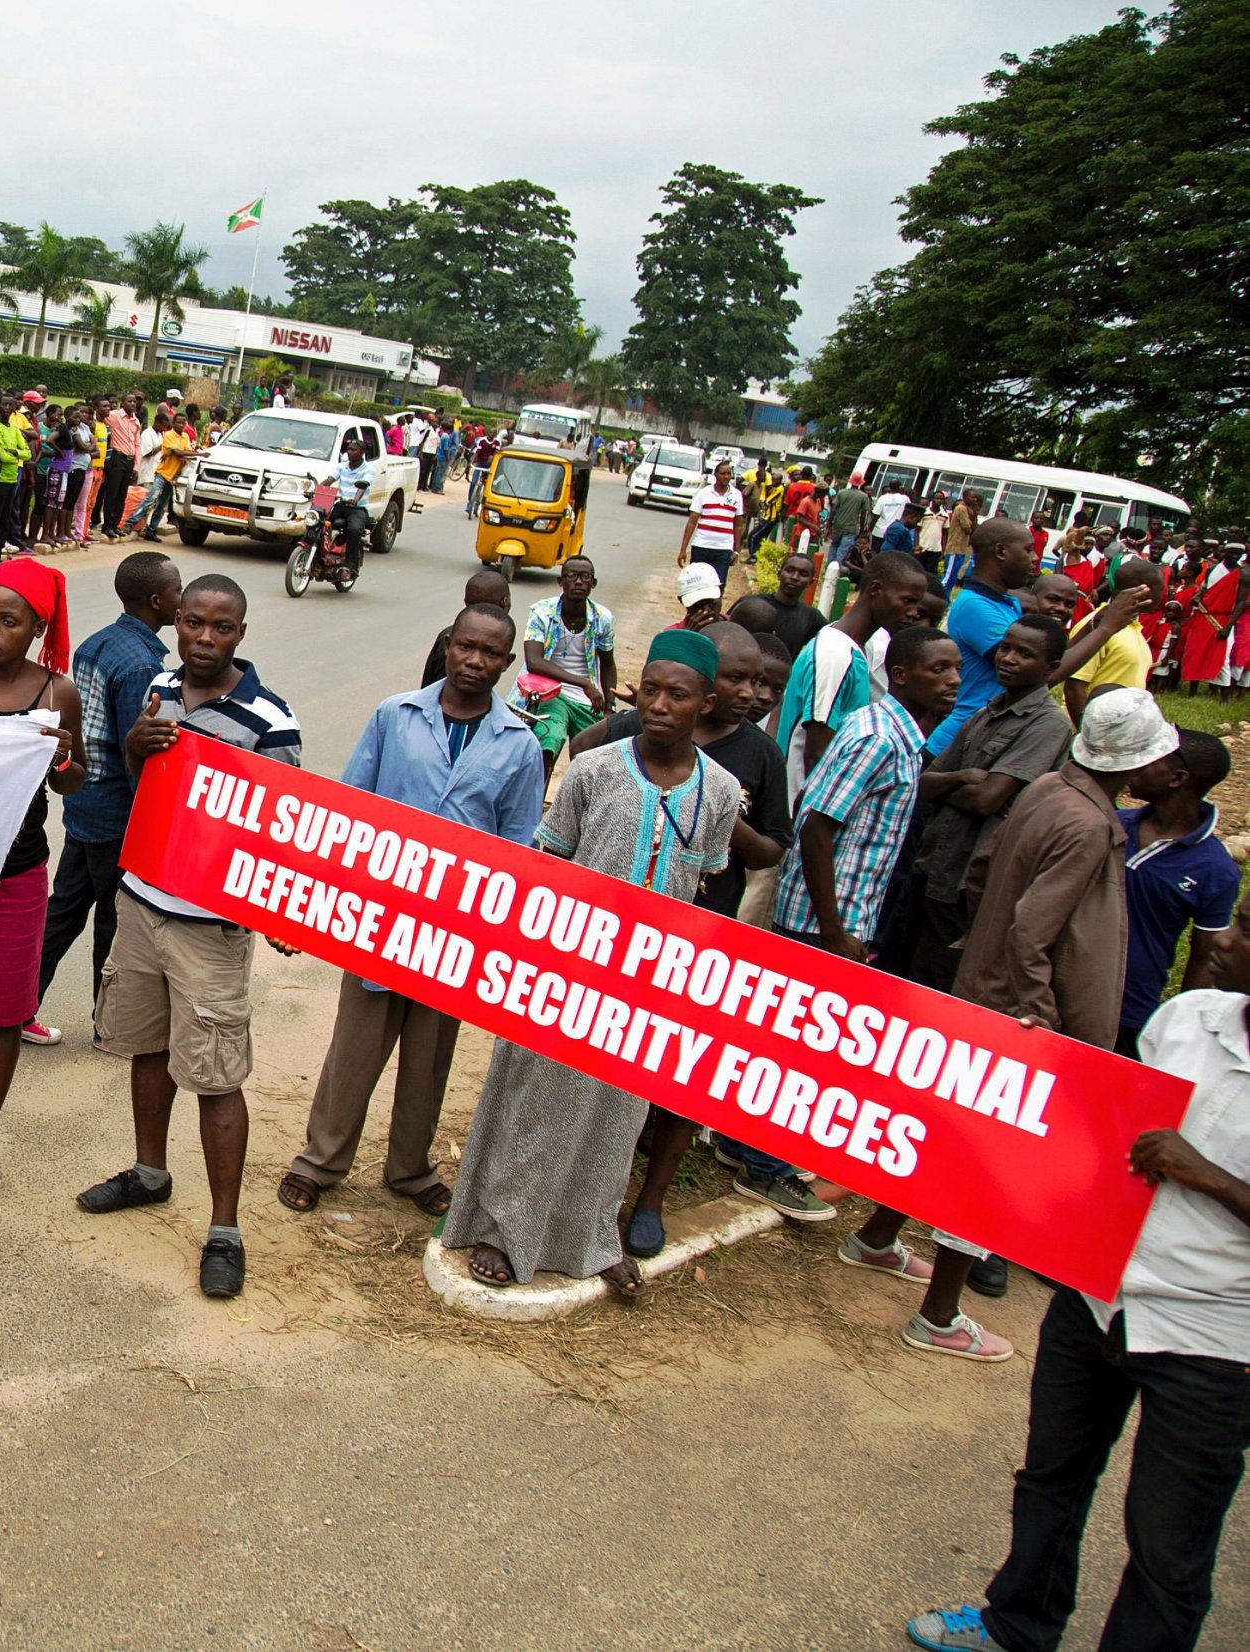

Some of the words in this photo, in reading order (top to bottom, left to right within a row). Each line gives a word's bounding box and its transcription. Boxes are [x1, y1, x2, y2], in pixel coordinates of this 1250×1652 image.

[270, 327, 332, 353] NISSAN
[186, 763, 267, 834] FULL
[269, 794, 458, 901] SUPPORT
[458, 859, 517, 925] TO
[519, 886, 621, 967] OUR
[621, 923, 1056, 1138] PROFFESSIONAL
[223, 848, 386, 953] DEFENSE
[381, 912, 475, 989] AND
[476, 950, 714, 1086] SECURITY
[707, 1044, 927, 1177] FORCES
